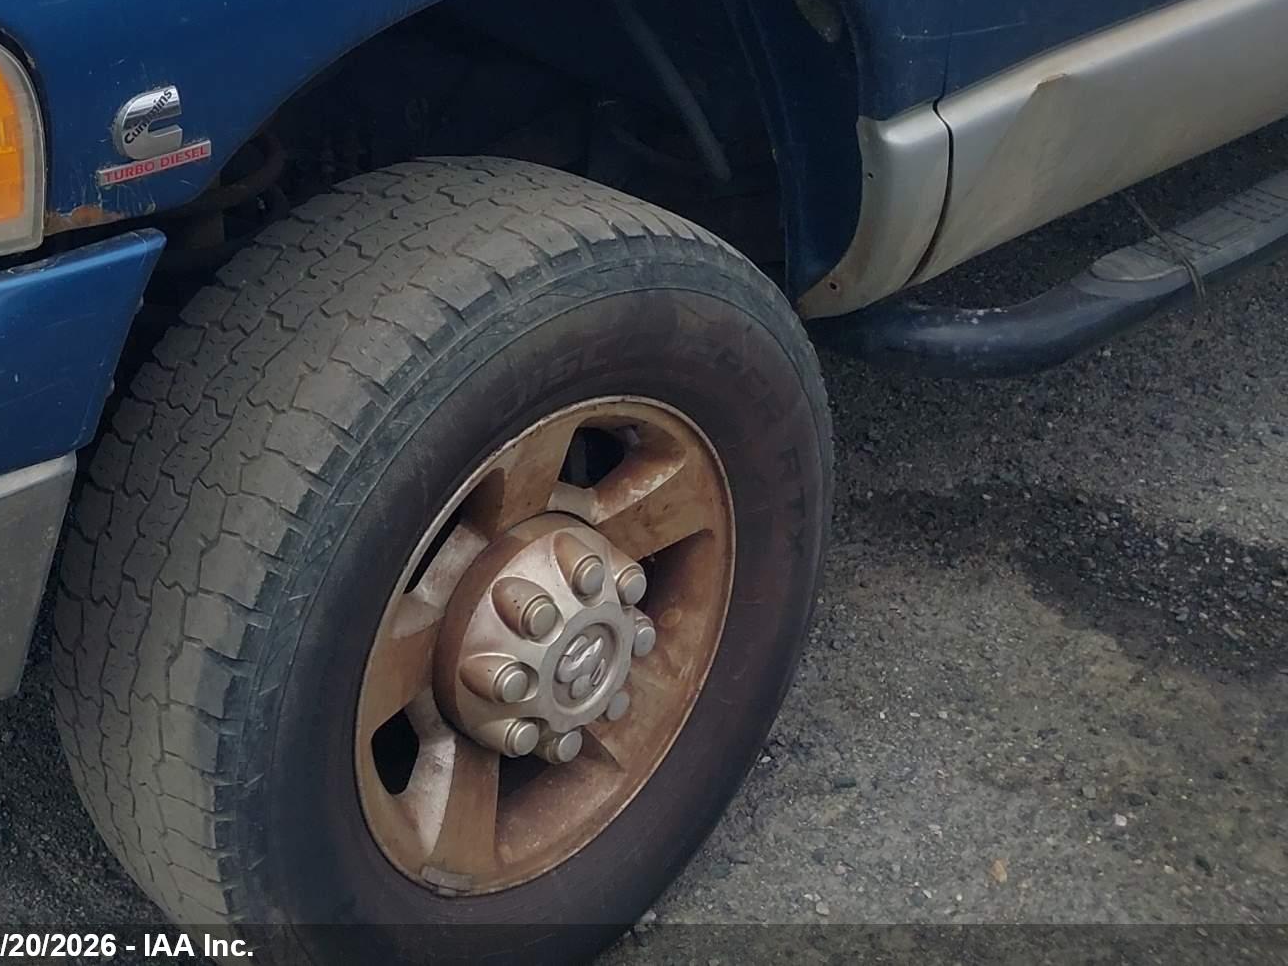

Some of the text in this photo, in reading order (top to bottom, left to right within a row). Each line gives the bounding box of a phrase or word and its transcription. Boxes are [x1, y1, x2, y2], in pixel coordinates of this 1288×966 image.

[123, 89, 173, 145] Cummins
[103, 145, 207, 183] TURBO DIESEL
